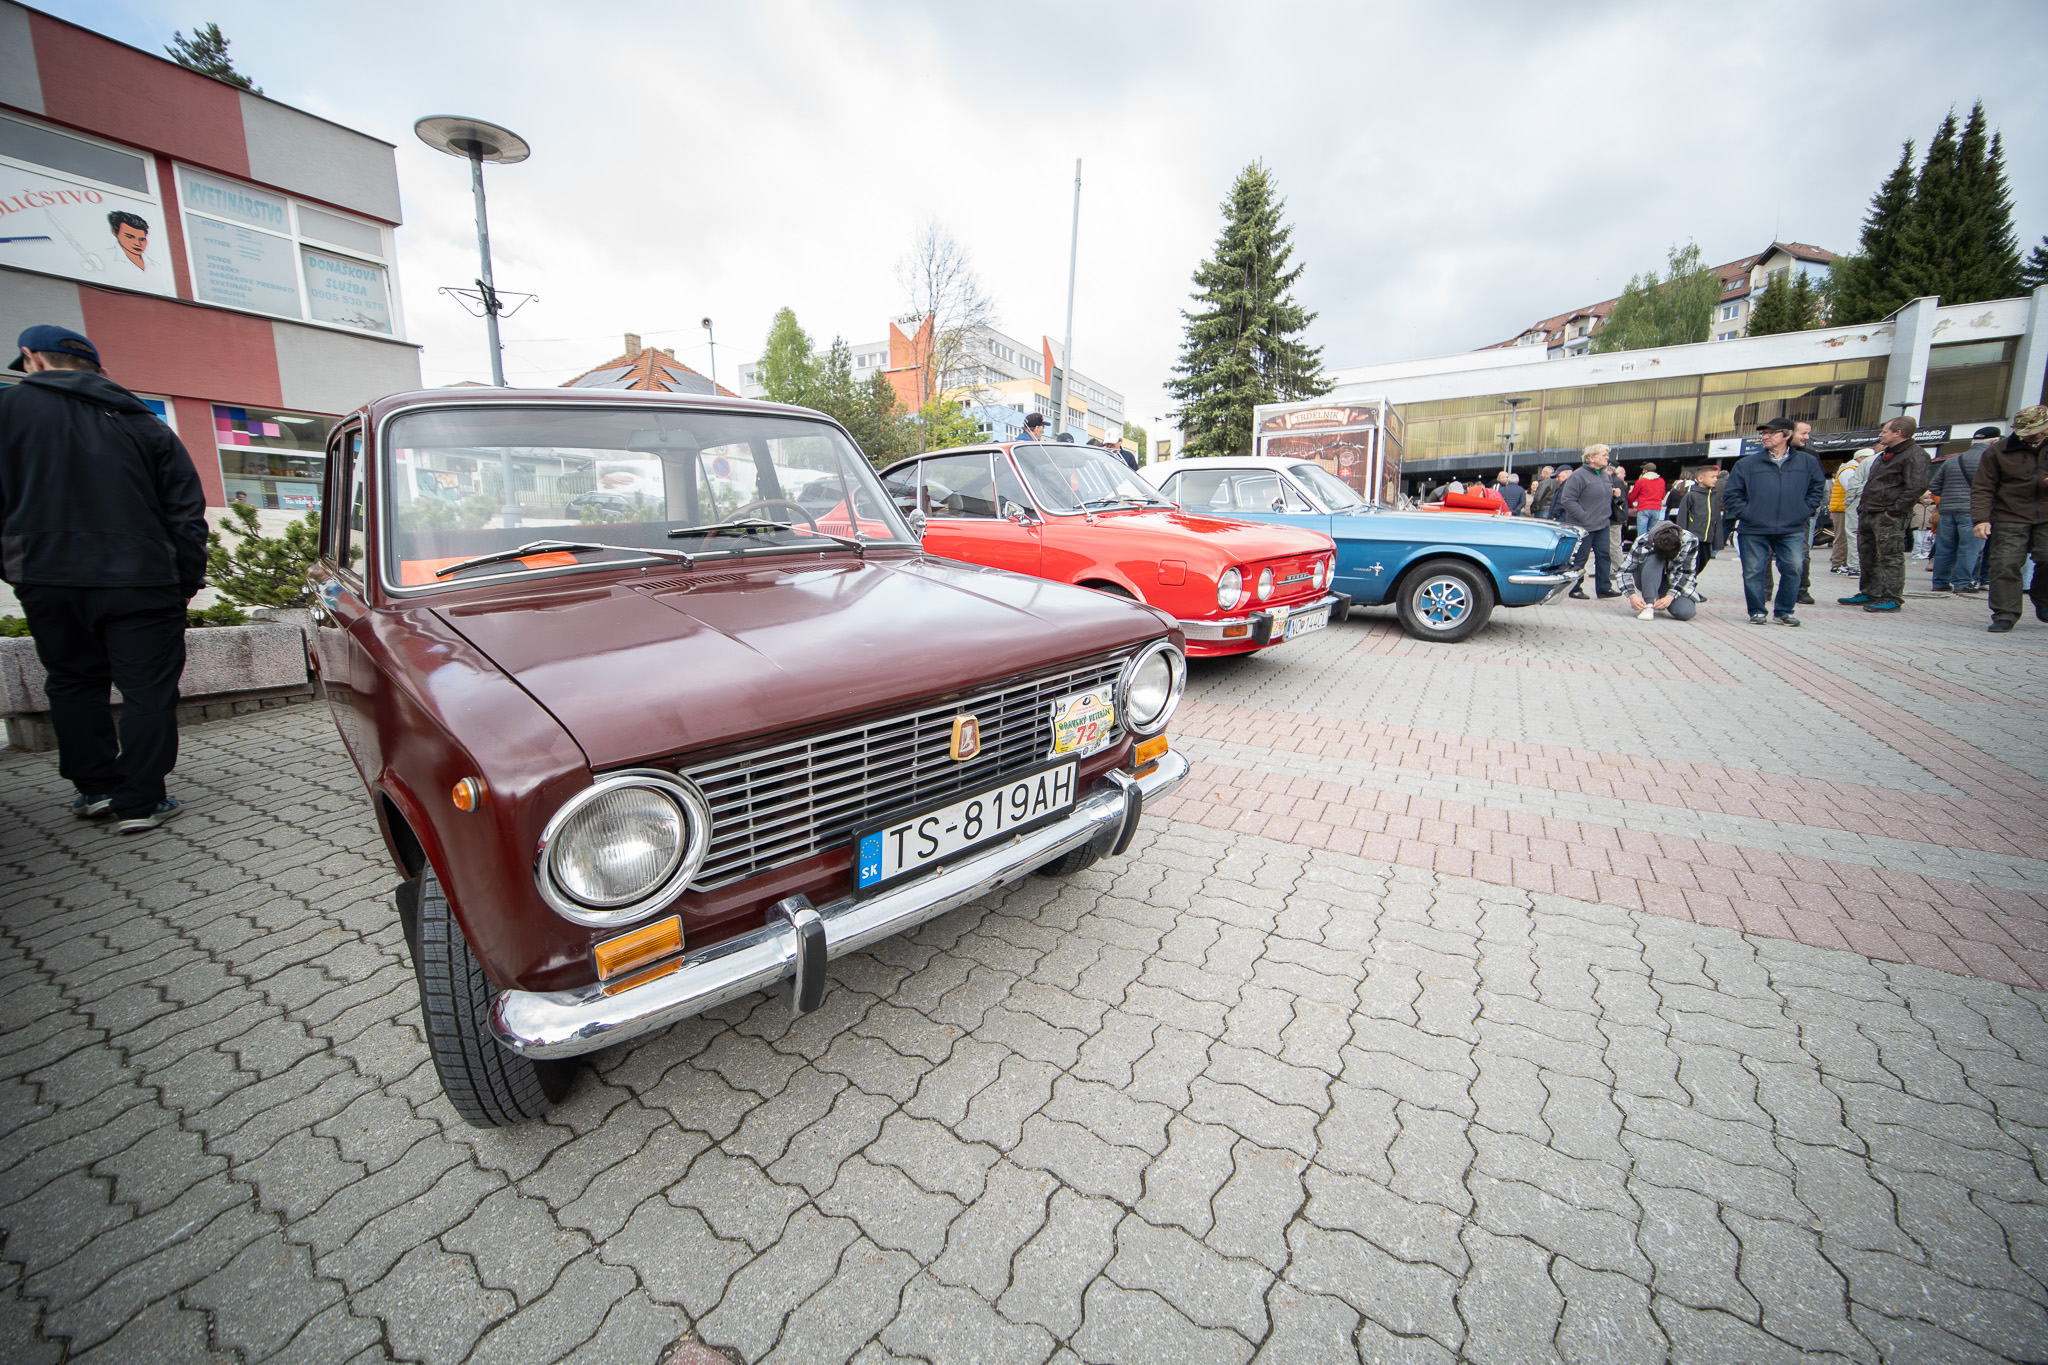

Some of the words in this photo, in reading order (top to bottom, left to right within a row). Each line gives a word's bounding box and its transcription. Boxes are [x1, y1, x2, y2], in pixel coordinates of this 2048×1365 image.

[188, 180, 283, 225] KVETINÁRSTVO
[308, 256, 377, 283] DONÁŠKOVÁ
[310, 288, 340, 302] 0905
[325, 278, 367, 297] SLUŽBA
[1075, 722, 1098, 746] 72
[889, 765, 1072, 869] TS-819AH
[861, 863, 879, 880] SK
